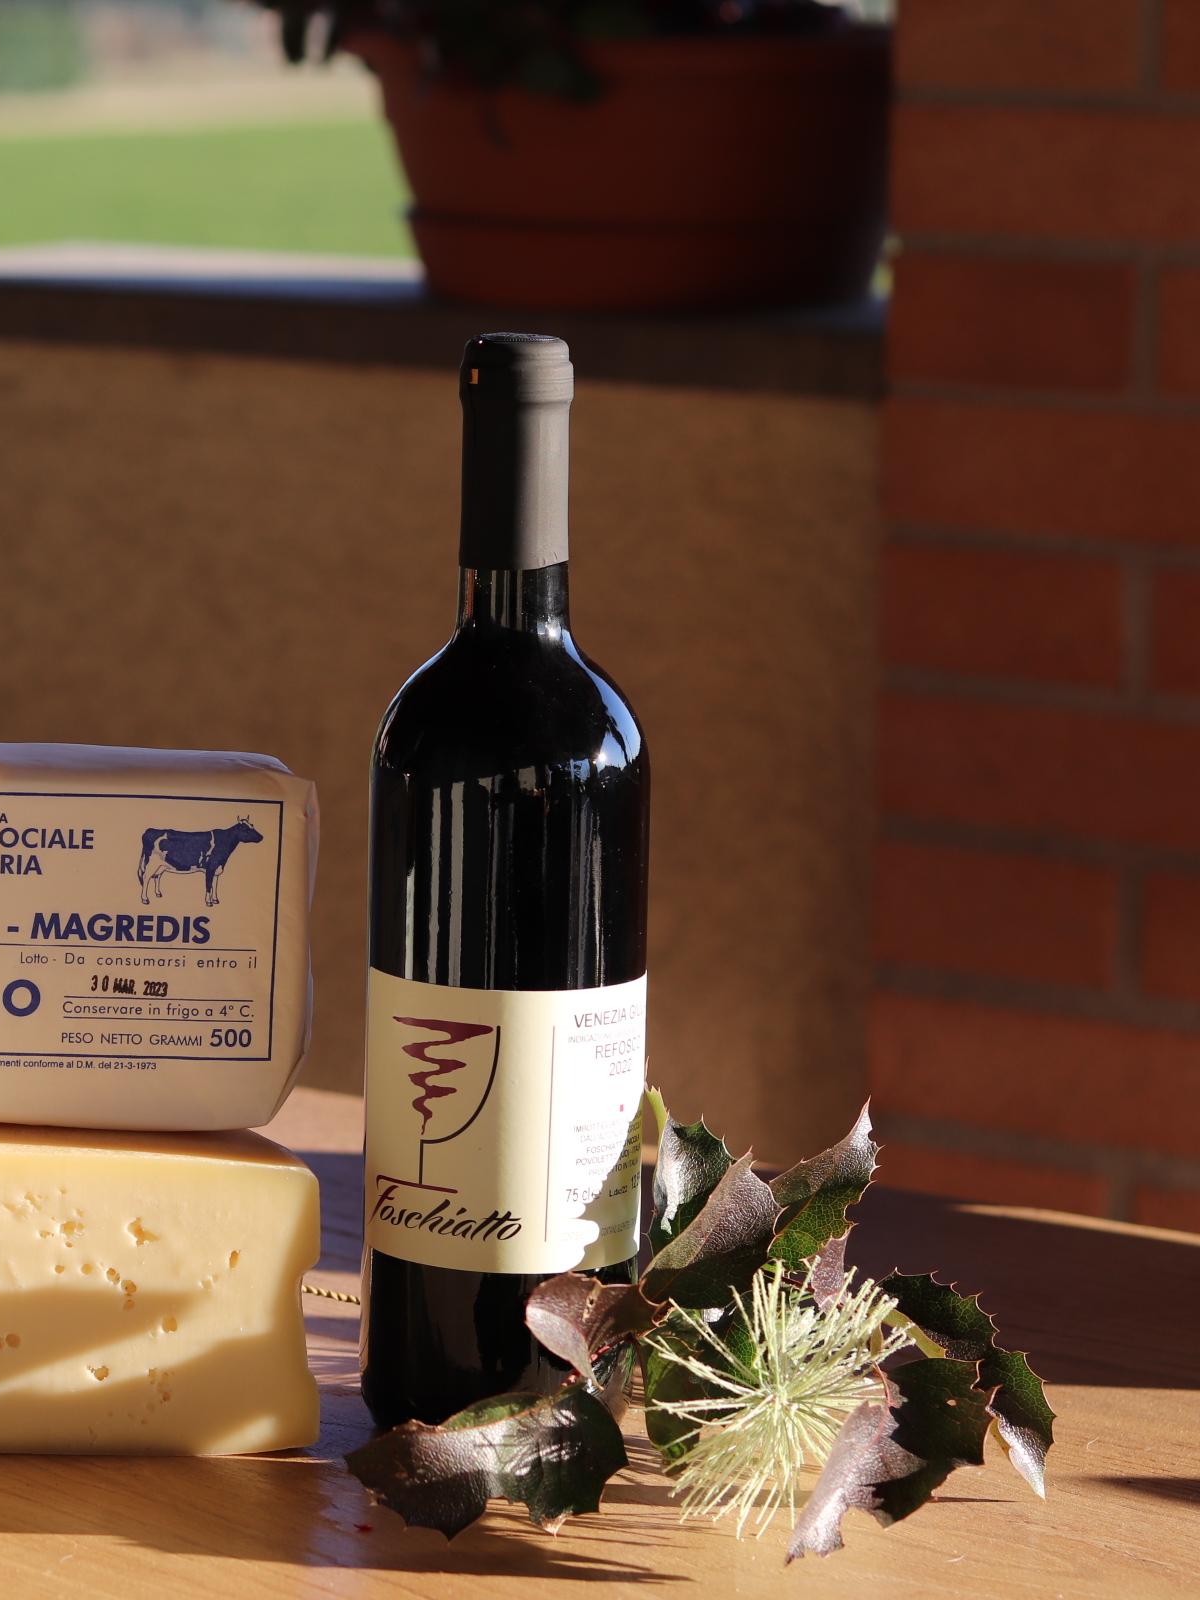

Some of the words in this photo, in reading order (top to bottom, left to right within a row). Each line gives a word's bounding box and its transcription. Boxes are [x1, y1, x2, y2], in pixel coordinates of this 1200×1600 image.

[30, 912, 211, 944] MAGREDIS
[20, 952, 49, 965] Lotto
[64, 952, 85, 965] Da
[96, 955, 186, 967] consumarsi
[197, 957, 237, 969] entro
[248, 957, 257, 969] il
[143, 981, 168, 997] 2023
[62, 1001, 142, 1015] Conservare
[149, 1002, 161, 1015] in
[167, 1004, 200, 1019] frigo
[205, 1009, 213, 1017] a
[240, 1005, 255, 1018] C.
[573, 1007, 627, 1029] VENEZIA
[61, 1032, 94, 1044] PESO
[100, 1033, 142, 1045] NETTO
[149, 1034, 202, 1047] GRAMMI
[209, 1029, 253, 1048] 500
[23, 1059, 64, 1069] conforme
[66, 1060, 74, 1069] al
[76, 1060, 95, 1069] D.M.
[98, 1060, 112, 1070] del
[113, 1060, 157, 1071] 21-3-1973
[565, 1188, 579, 1203] 75
[368, 1175, 522, 1242] Foschiatto
